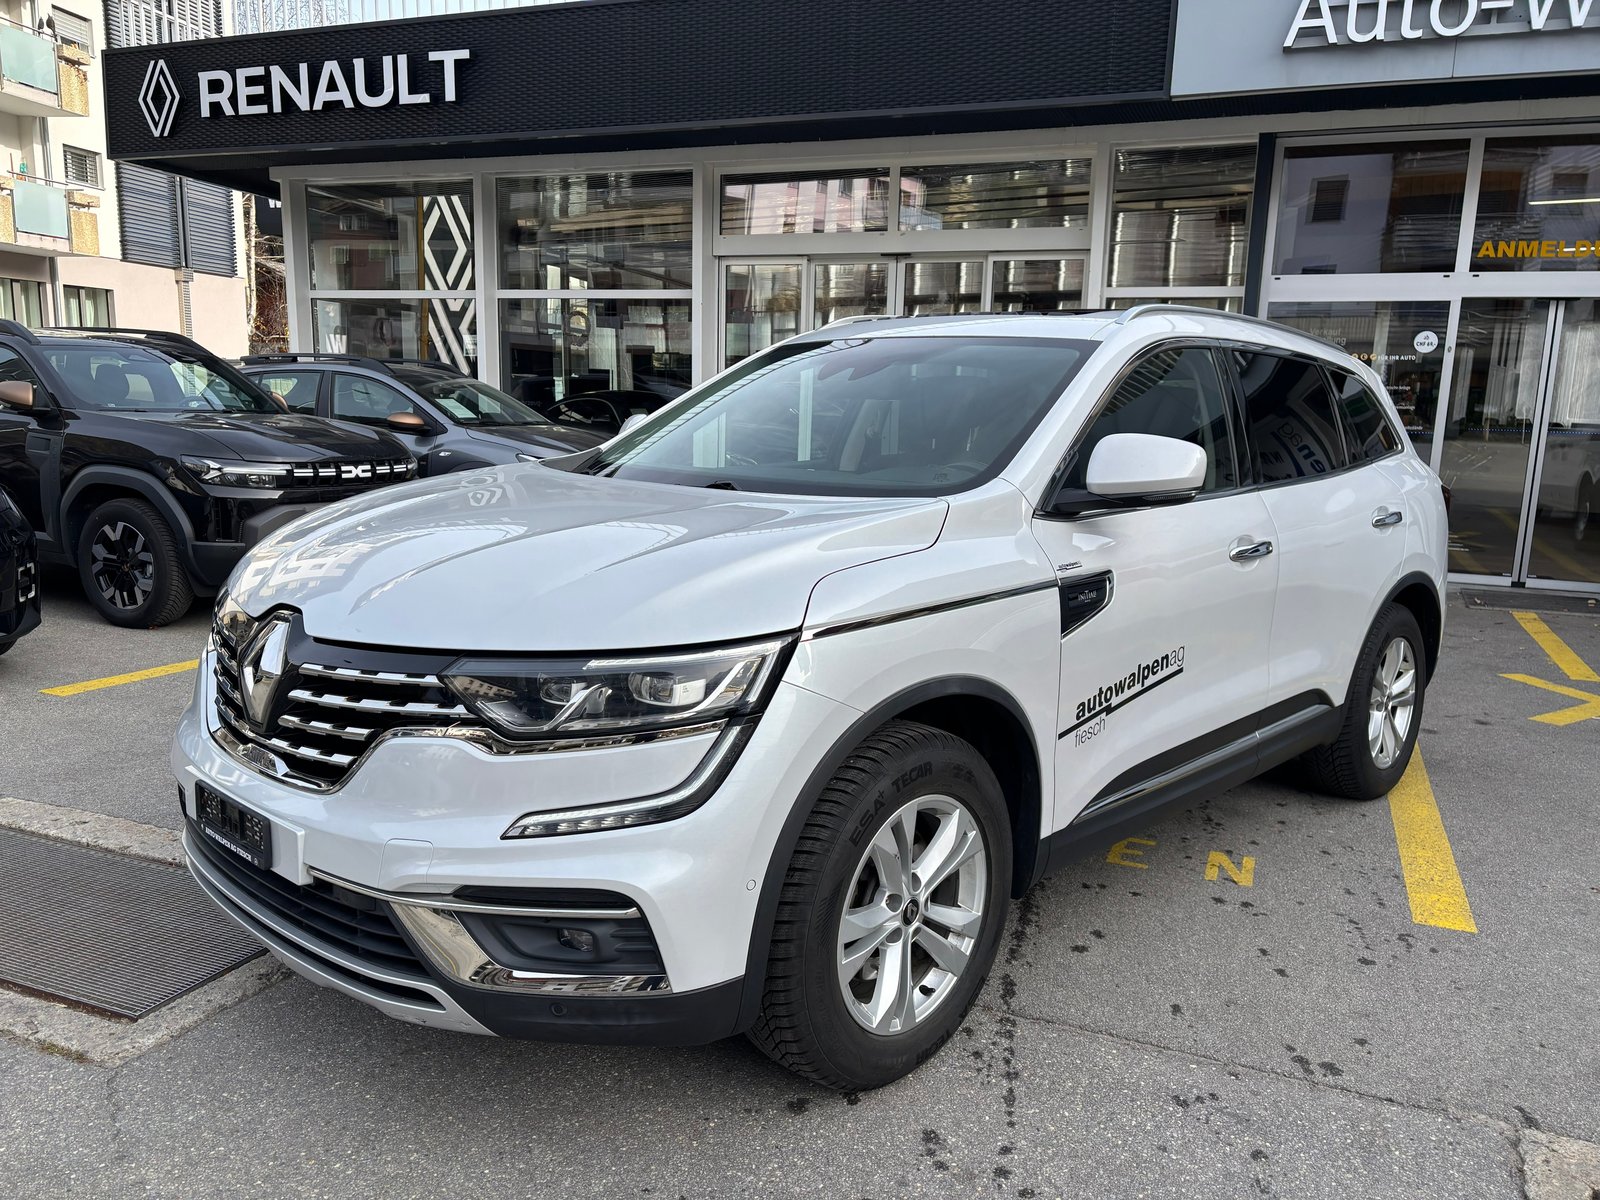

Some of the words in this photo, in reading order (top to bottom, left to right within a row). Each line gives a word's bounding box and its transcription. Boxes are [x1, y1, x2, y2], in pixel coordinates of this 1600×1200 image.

[198, 49, 470, 118] RENAULT
[1074, 716, 1106, 748] fiesch
[891, 760, 934, 794] TECAR
